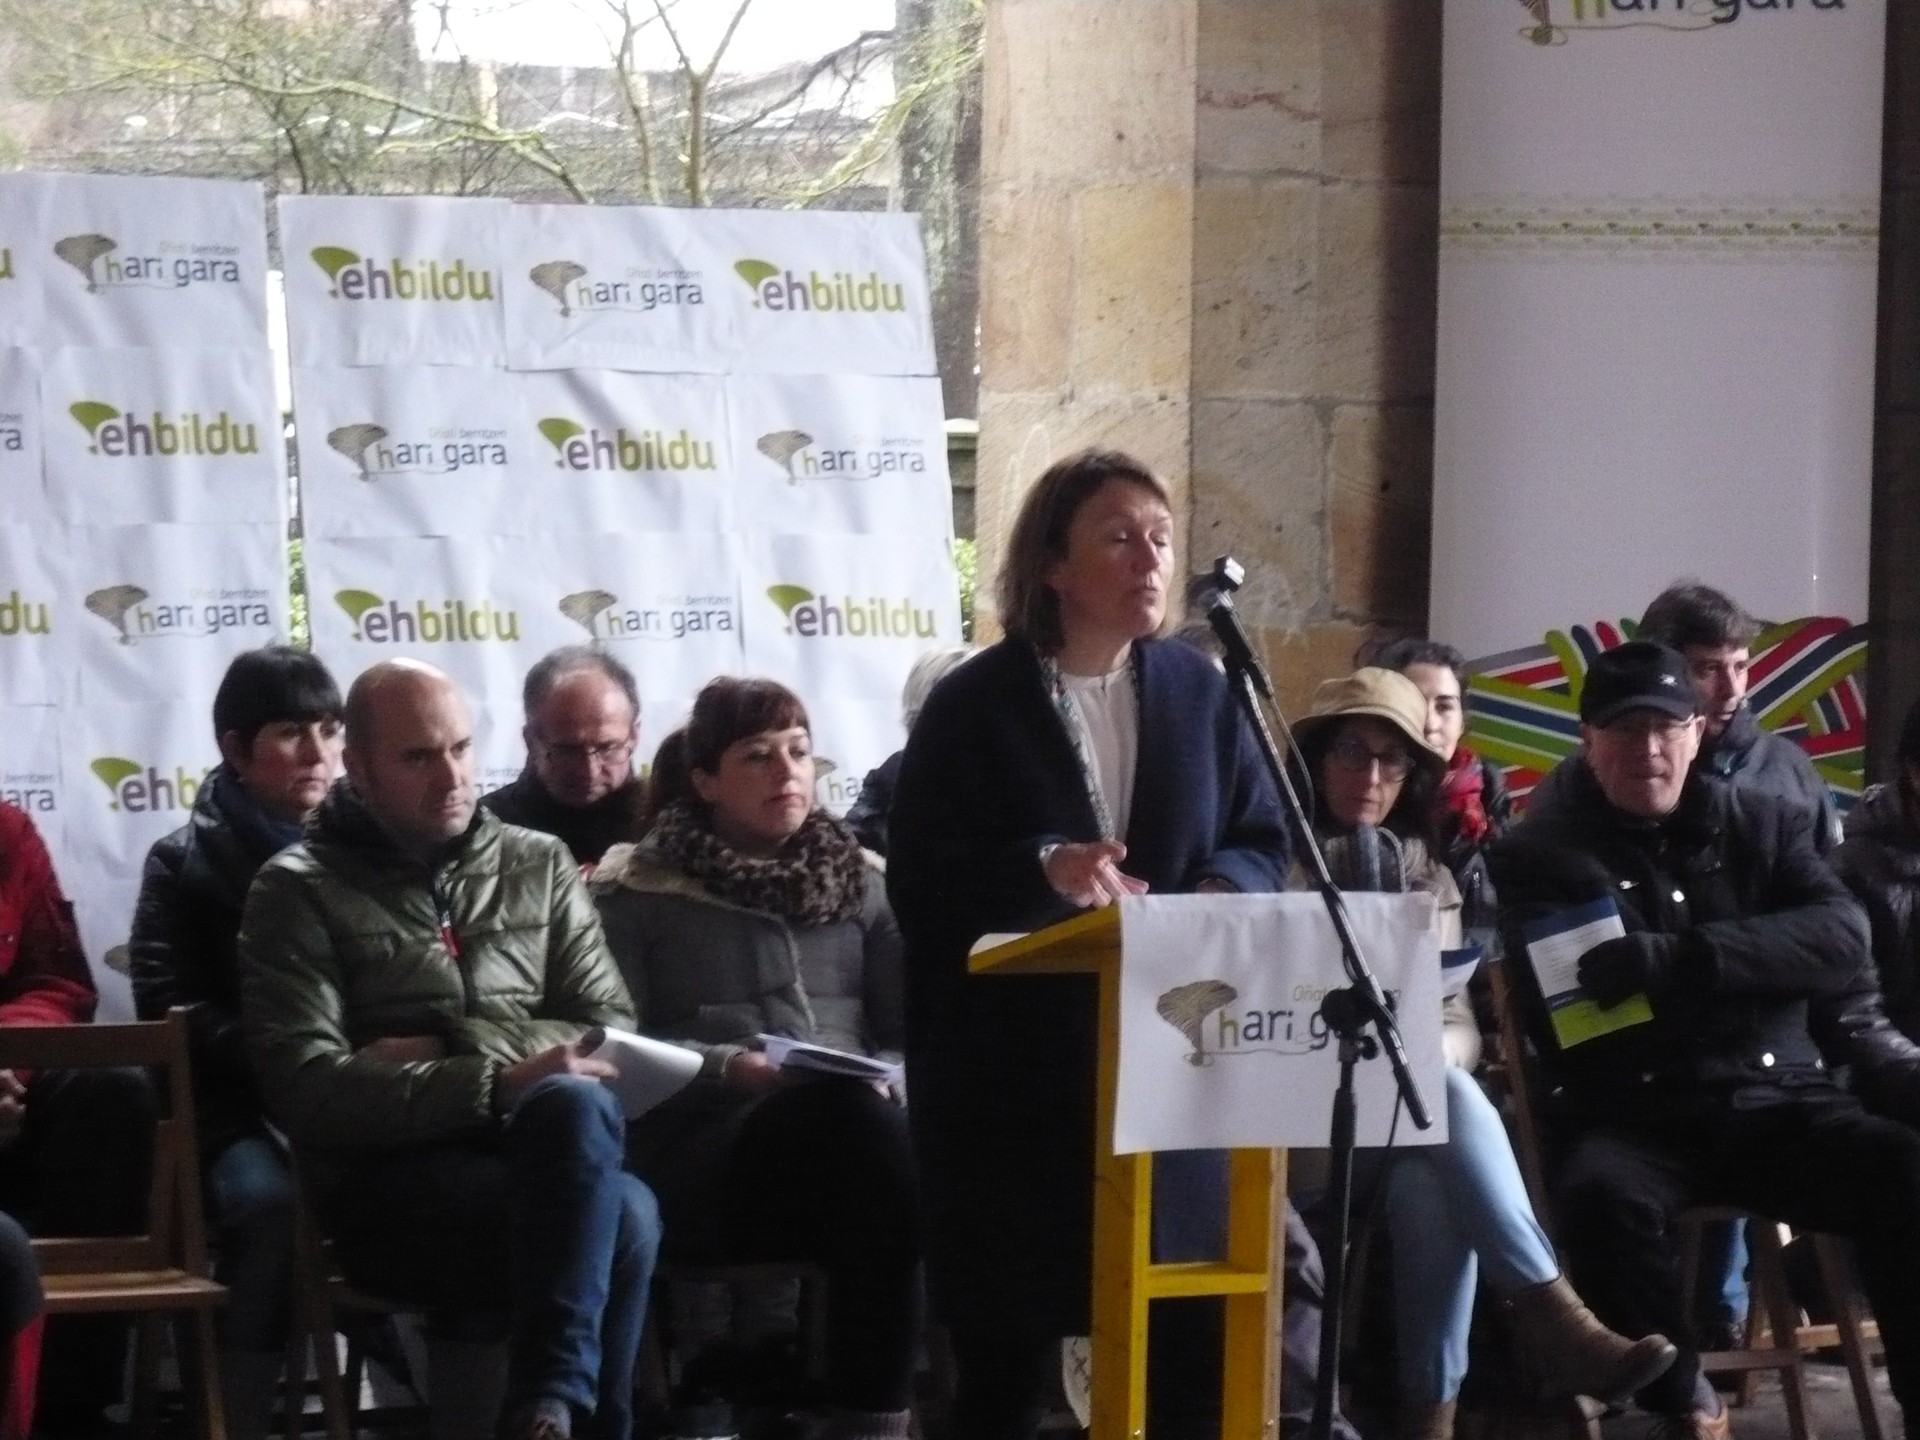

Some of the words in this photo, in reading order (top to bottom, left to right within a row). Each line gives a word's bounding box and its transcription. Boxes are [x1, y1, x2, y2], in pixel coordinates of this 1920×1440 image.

[105, 255, 162, 281] hari
[173, 258, 241, 287] gara
[341, 258, 493, 300] ehbildu
[577, 280, 630, 308] hari
[641, 280, 704, 309] gara
[763, 270, 906, 313] ehbildu
[101, 412, 259, 457] ehbildu
[566, 428, 718, 472] ehbildu
[376, 440, 433, 471] hari
[443, 443, 508, 472] gara
[803, 446, 857, 475] hari
[870, 447, 926, 477] gara
[138, 604, 195, 633] hari
[205, 602, 271, 634] gara
[364, 600, 520, 643] ehbildu
[608, 604, 662, 637] hari
[671, 604, 734, 638] gara
[794, 594, 937, 638] ehbildu
[0, 788, 56, 811] ara
[1218, 1008, 1294, 1048] hari
